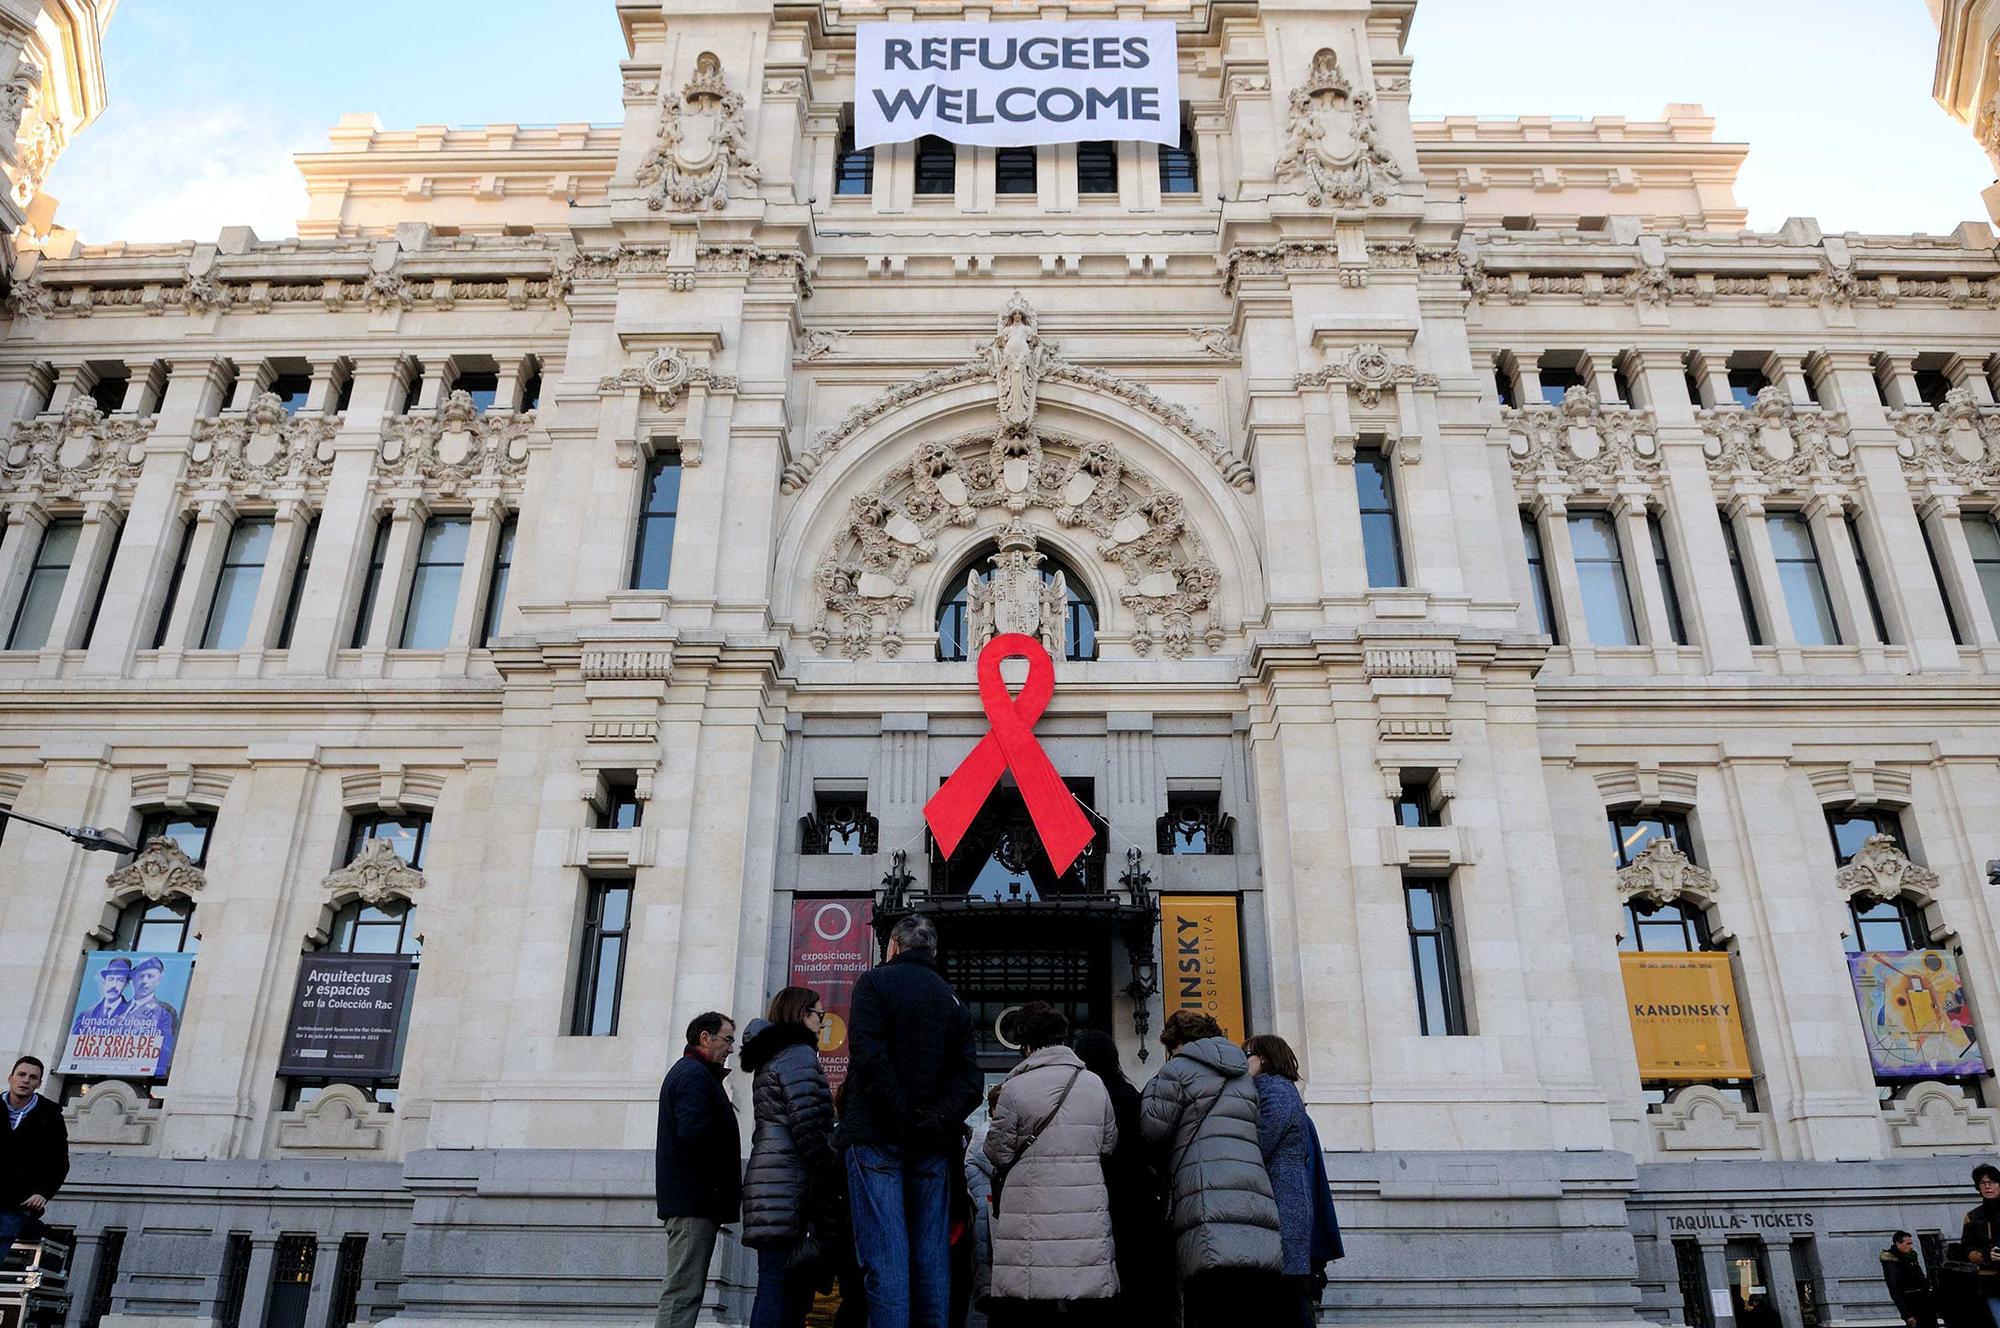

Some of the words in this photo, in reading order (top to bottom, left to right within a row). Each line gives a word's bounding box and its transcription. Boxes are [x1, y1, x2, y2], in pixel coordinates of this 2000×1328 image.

[885, 37, 1150, 71] REFUGEES
[872, 84, 1160, 124] WELCOME
[801, 950, 862, 961] exposiciones
[794, 962, 831, 972] mirador
[833, 962, 868, 972] madrid
[1177, 916, 1202, 1008] INSKY
[1204, 915, 1218, 1010] OSPECTIVA
[308, 969, 393, 984] Arquitecturas
[304, 985, 314, 997] y
[316, 983, 371, 997] espacios
[302, 1000, 314, 1008] en
[316, 999, 326, 1008] la
[328, 998, 372, 1009] Colección
[375, 1000, 393, 1009] Rac
[1635, 1004, 1730, 1016] KANDINSKY
[81, 1016, 116, 1027] Ignacio
[118, 1016, 158, 1027] Zuloaga
[79, 1027, 85, 1035] y
[86, 1026, 123, 1035] Manuel
[123, 1026, 137, 1035] de
[138, 1027, 162, 1036] Falla
[76, 1035, 134, 1047] HISTORIA
[138, 1036, 155, 1047] DE
[73, 1046, 100, 1057] UNA
[102, 1046, 161, 1059] AMISTAD
[817, 1056, 849, 1064] RMACIÓ
[823, 1065, 848, 1073] STICA
[1667, 1215, 1740, 1230] TAQUILLA
[1751, 1213, 1814, 1228] TICKETS
